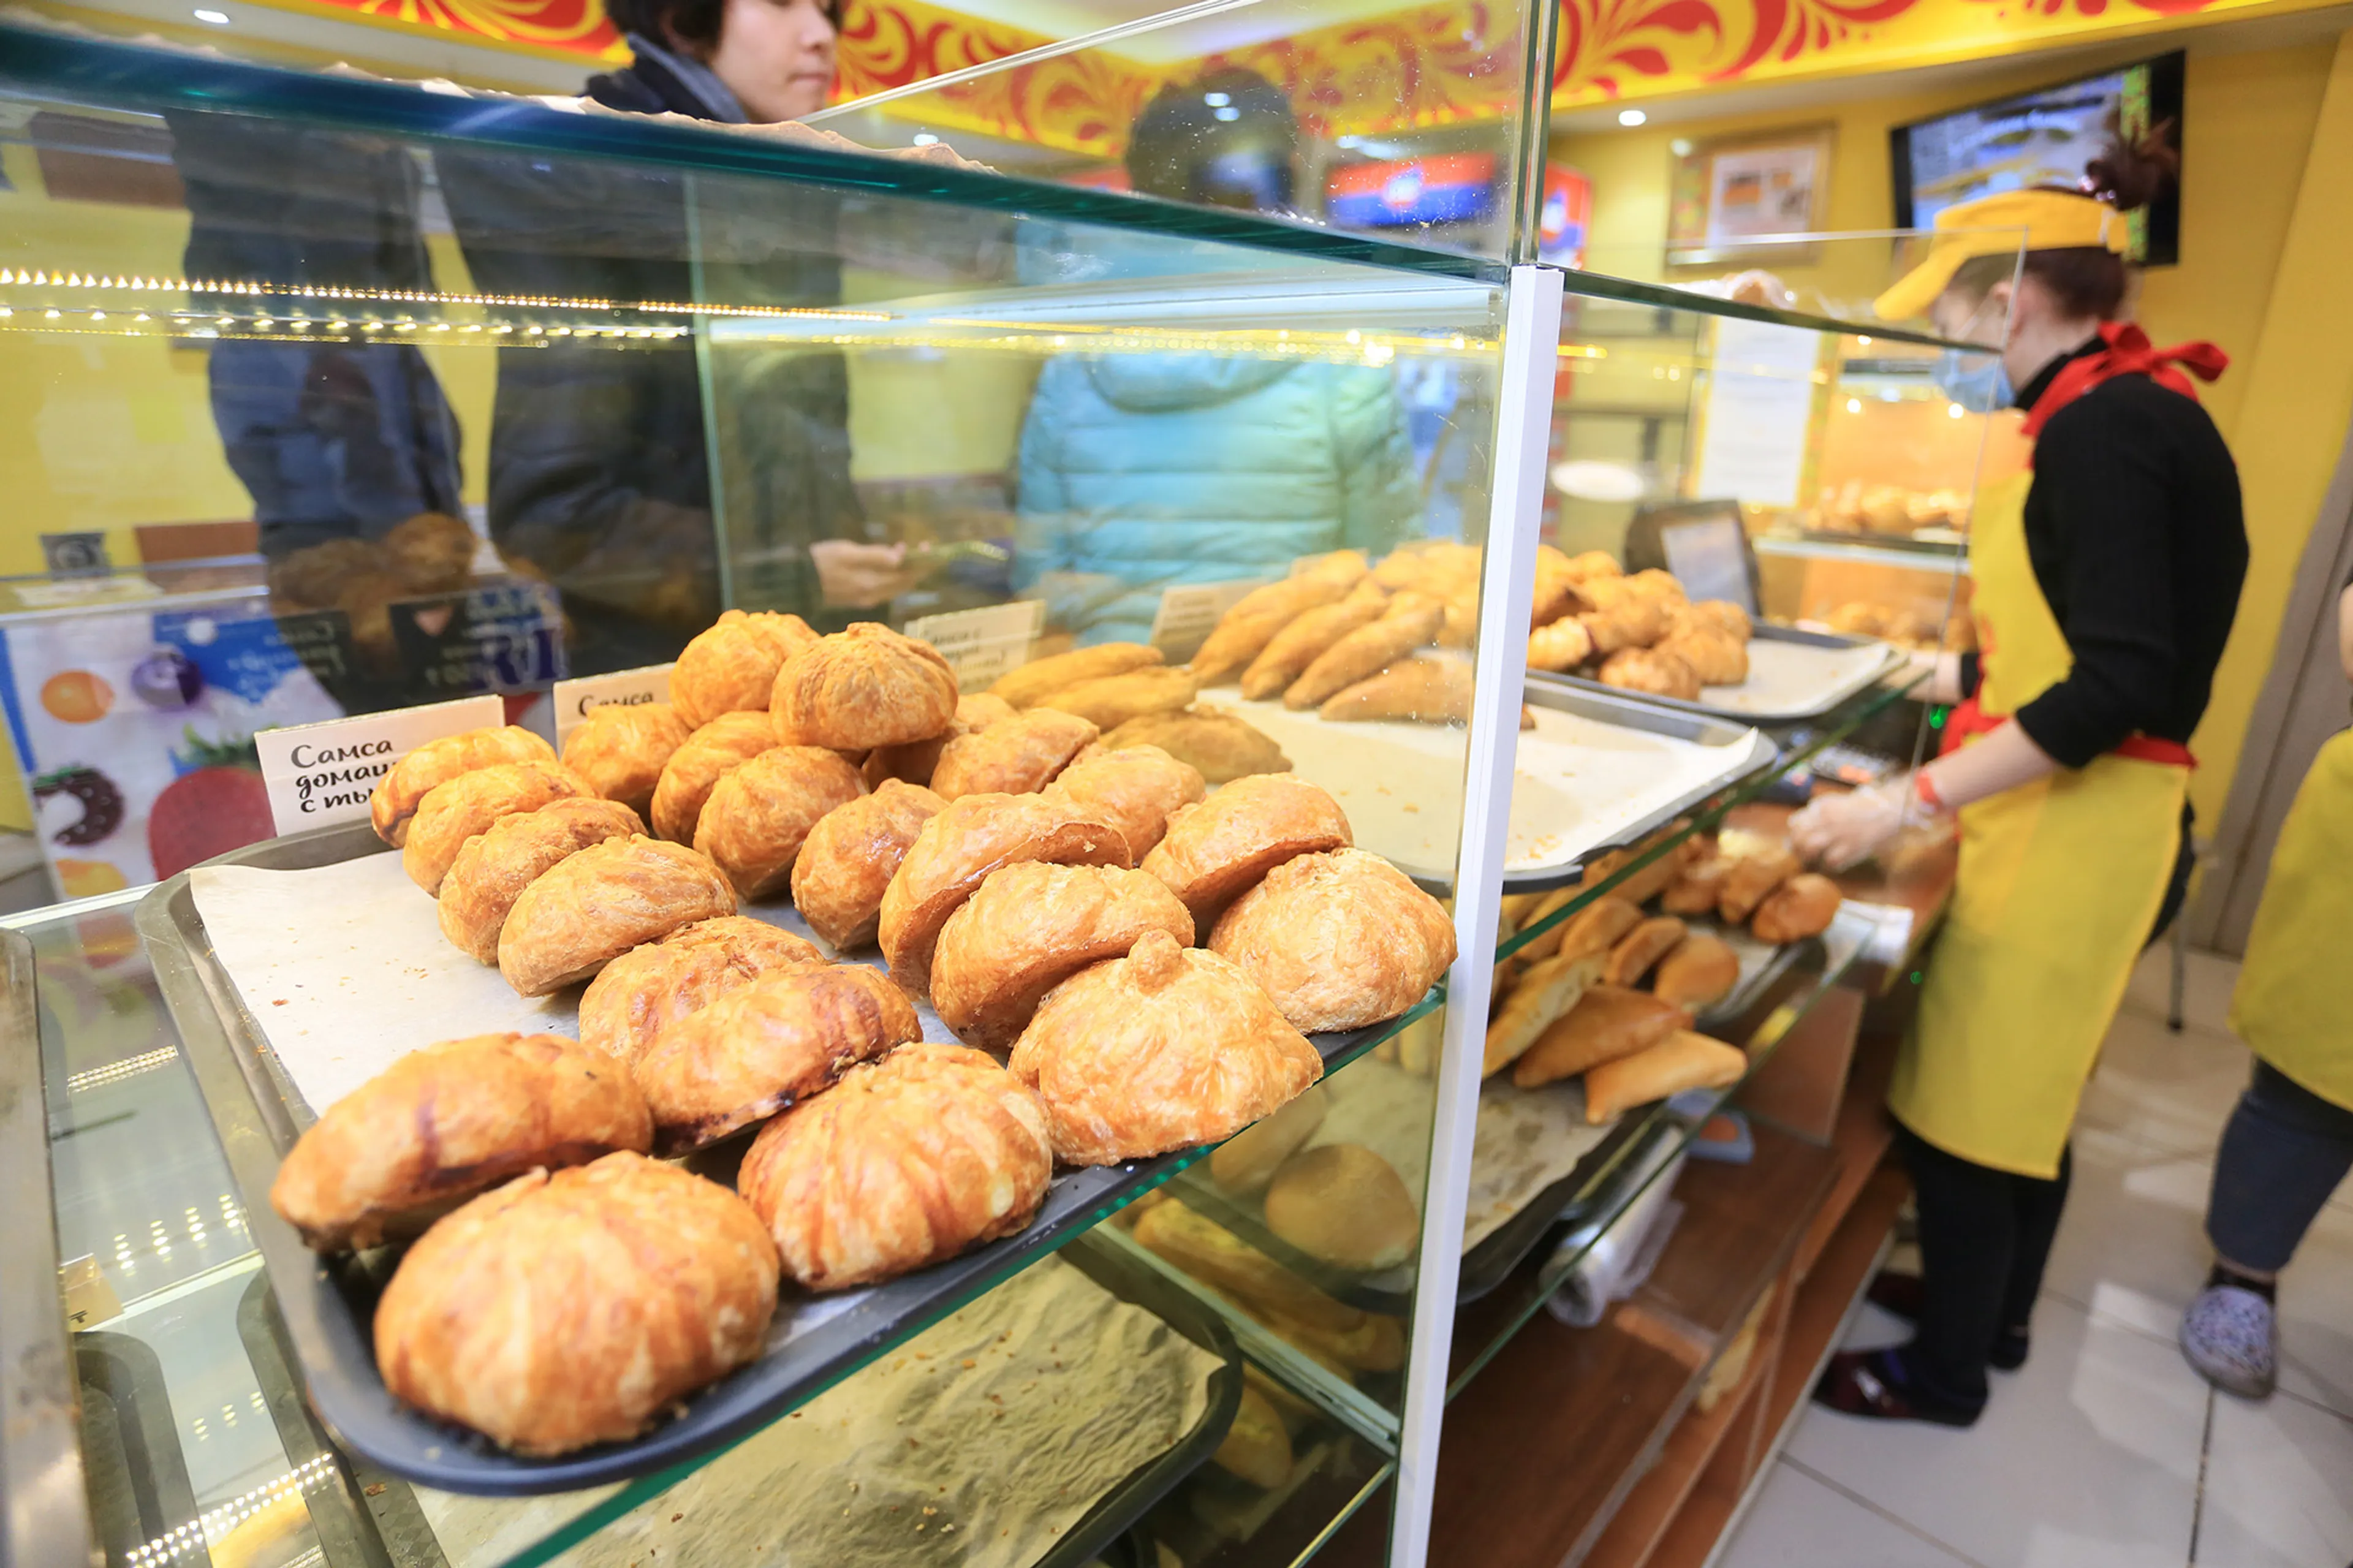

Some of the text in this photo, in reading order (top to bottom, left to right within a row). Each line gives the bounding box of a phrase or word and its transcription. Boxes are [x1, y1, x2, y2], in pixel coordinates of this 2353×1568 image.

[290, 740, 393, 768] Самса
[295, 762, 398, 800] домаш
[300, 788, 374, 813] с ты
